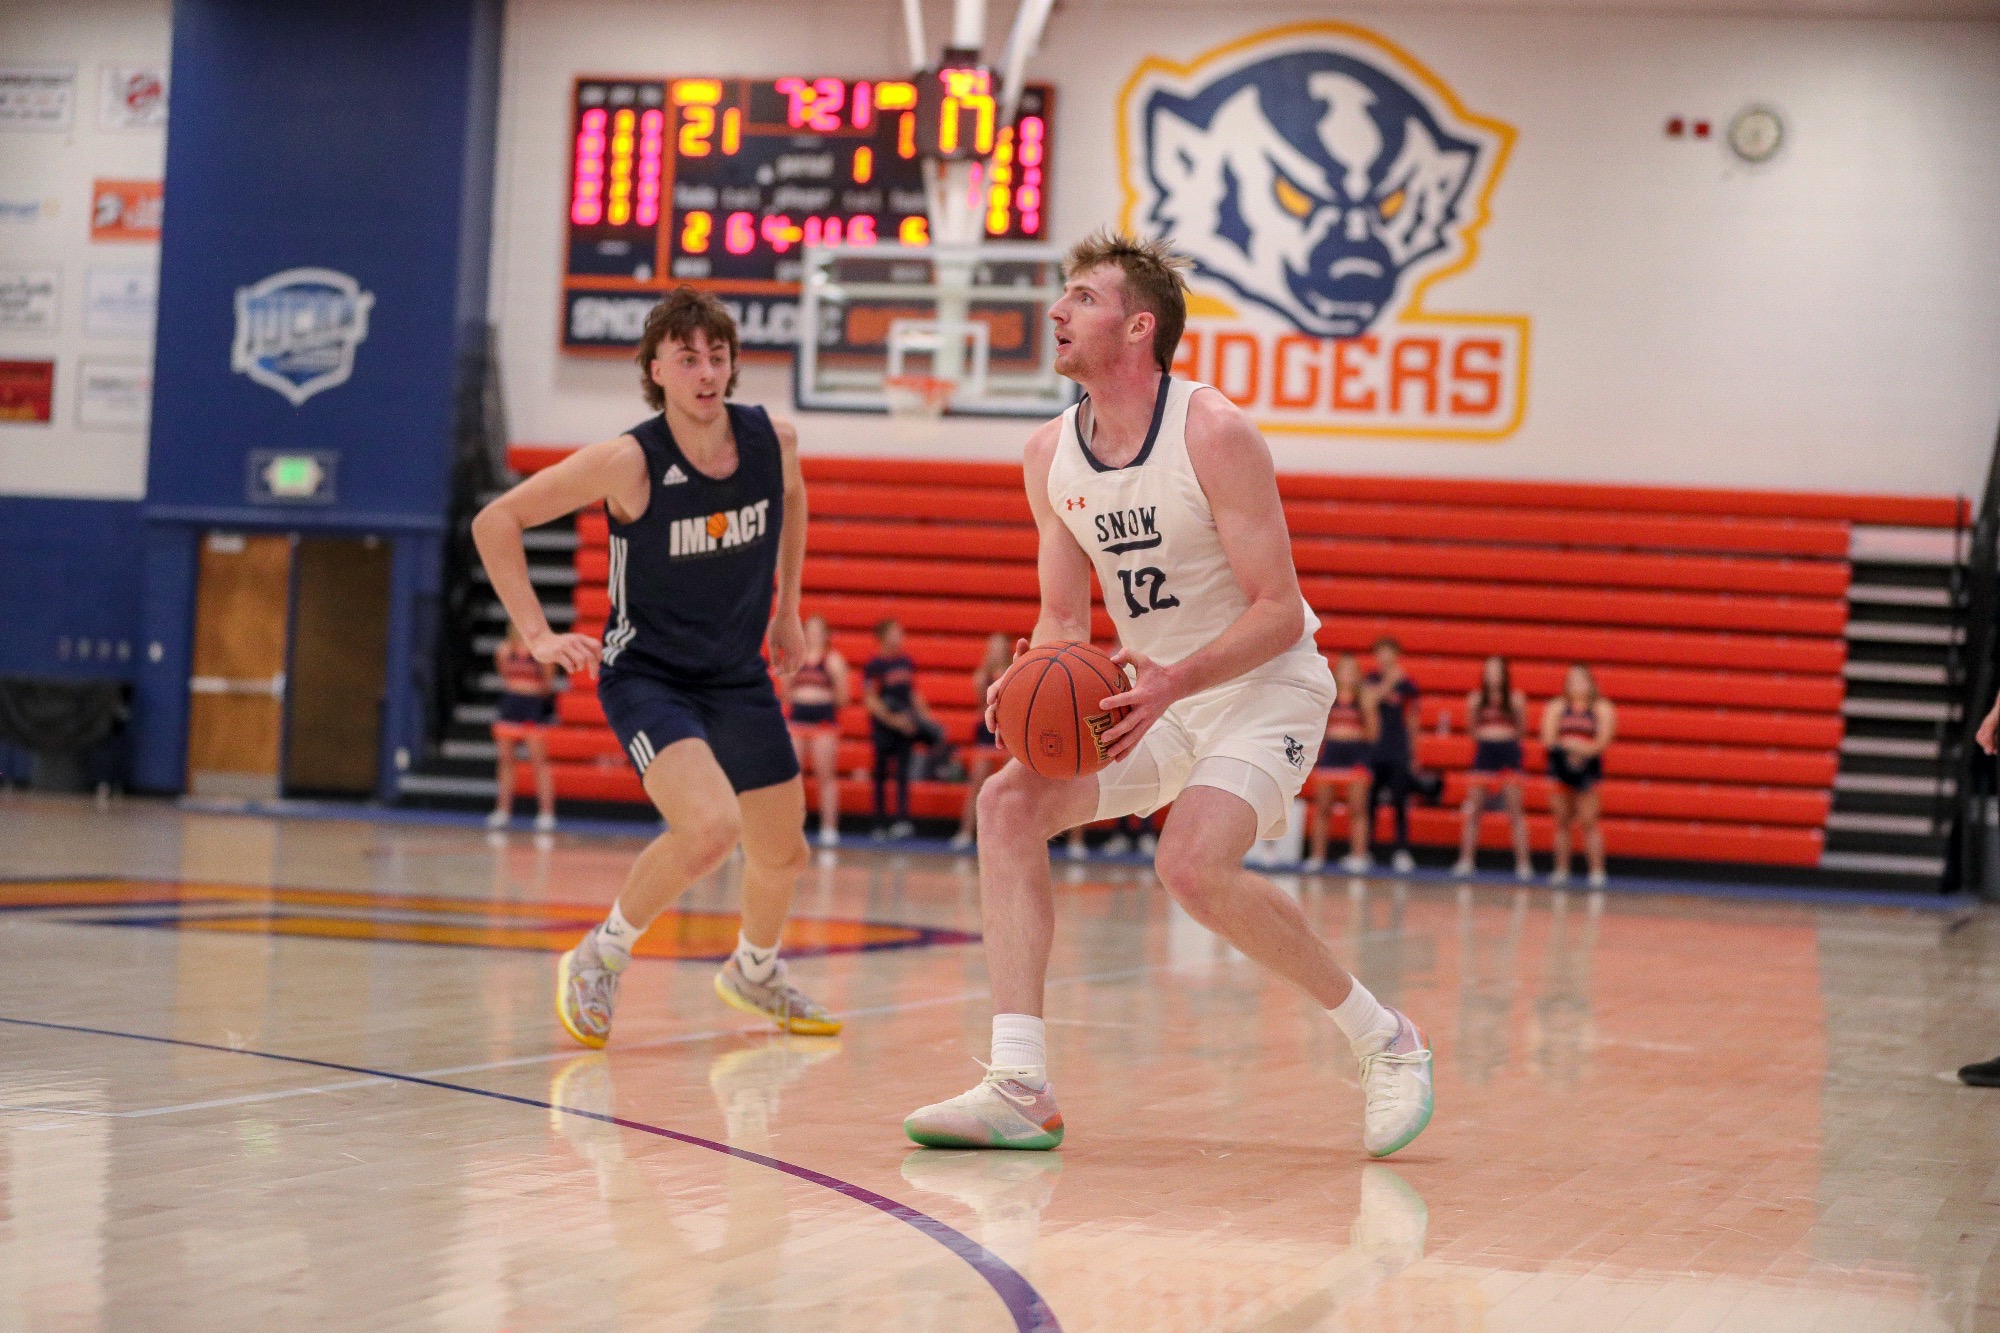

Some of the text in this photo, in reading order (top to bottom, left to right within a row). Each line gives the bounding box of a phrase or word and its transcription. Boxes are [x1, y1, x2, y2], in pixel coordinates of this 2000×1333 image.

[774, 78, 872, 131] 7:21
[678, 105, 742, 157] 21
[1171, 332, 1504, 416] DGERS
[669, 499, 770, 557] IMPACT
[1095, 506, 1159, 544] SNOW
[1117, 567, 1181, 619] 12
